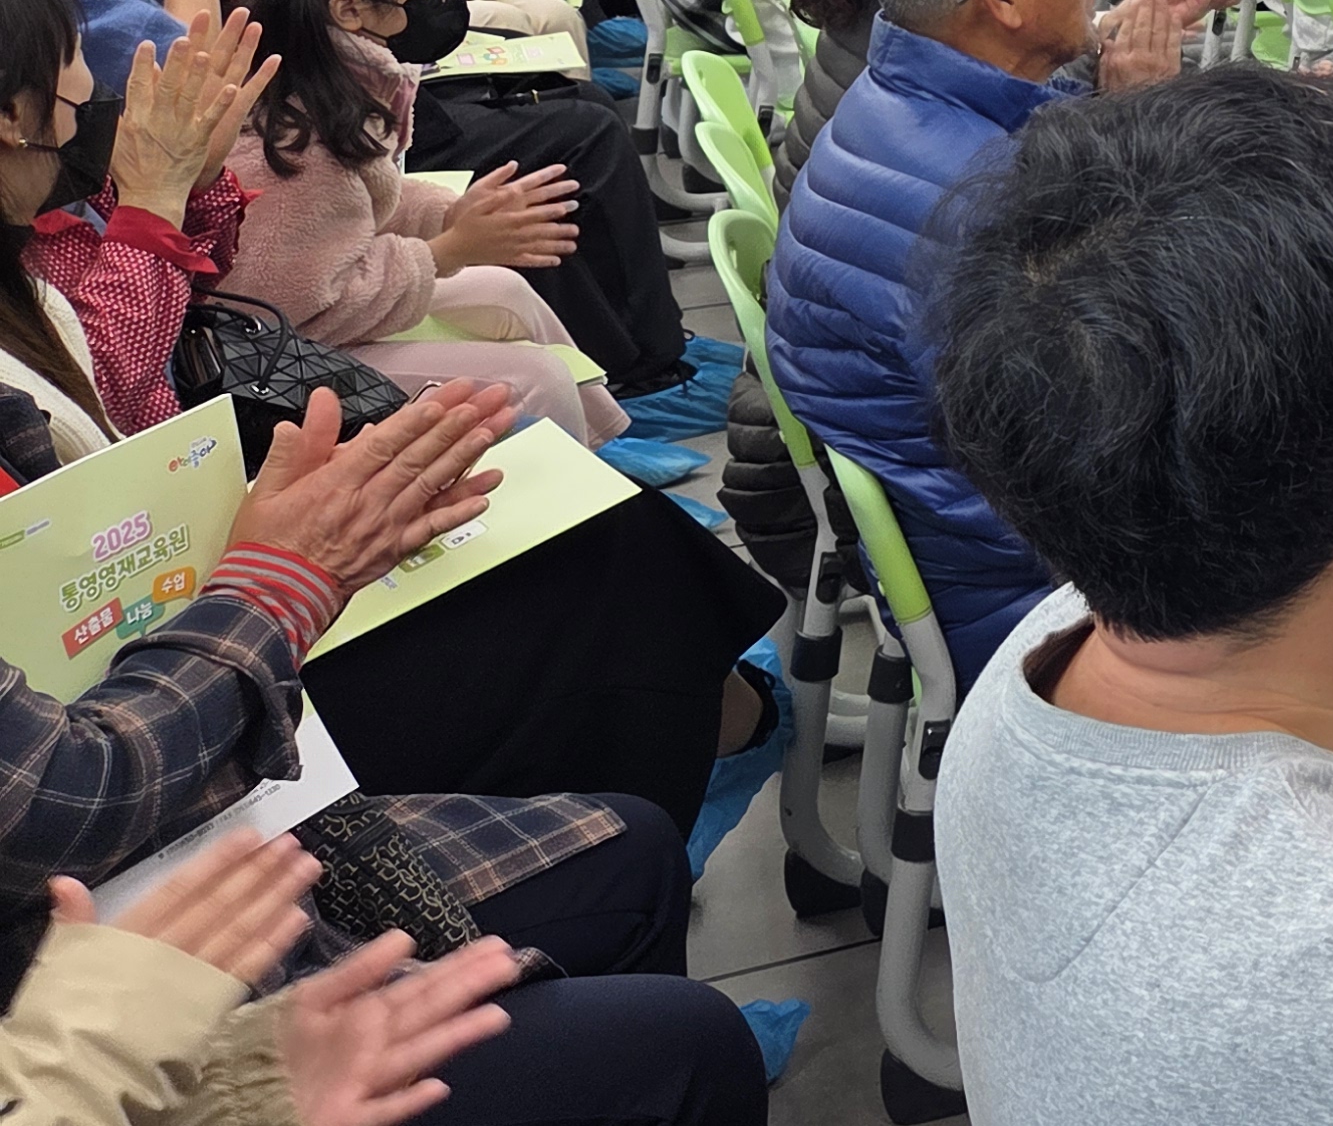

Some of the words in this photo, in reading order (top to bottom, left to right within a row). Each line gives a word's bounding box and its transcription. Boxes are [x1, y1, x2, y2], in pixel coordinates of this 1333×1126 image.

[60, 525, 188, 610] 통영영재교육원
[92, 512, 151, 560] 2025
[73, 606, 115, 646] 산출물
[126, 601, 153, 624] 나눔
[161, 571, 186, 594] 수업
